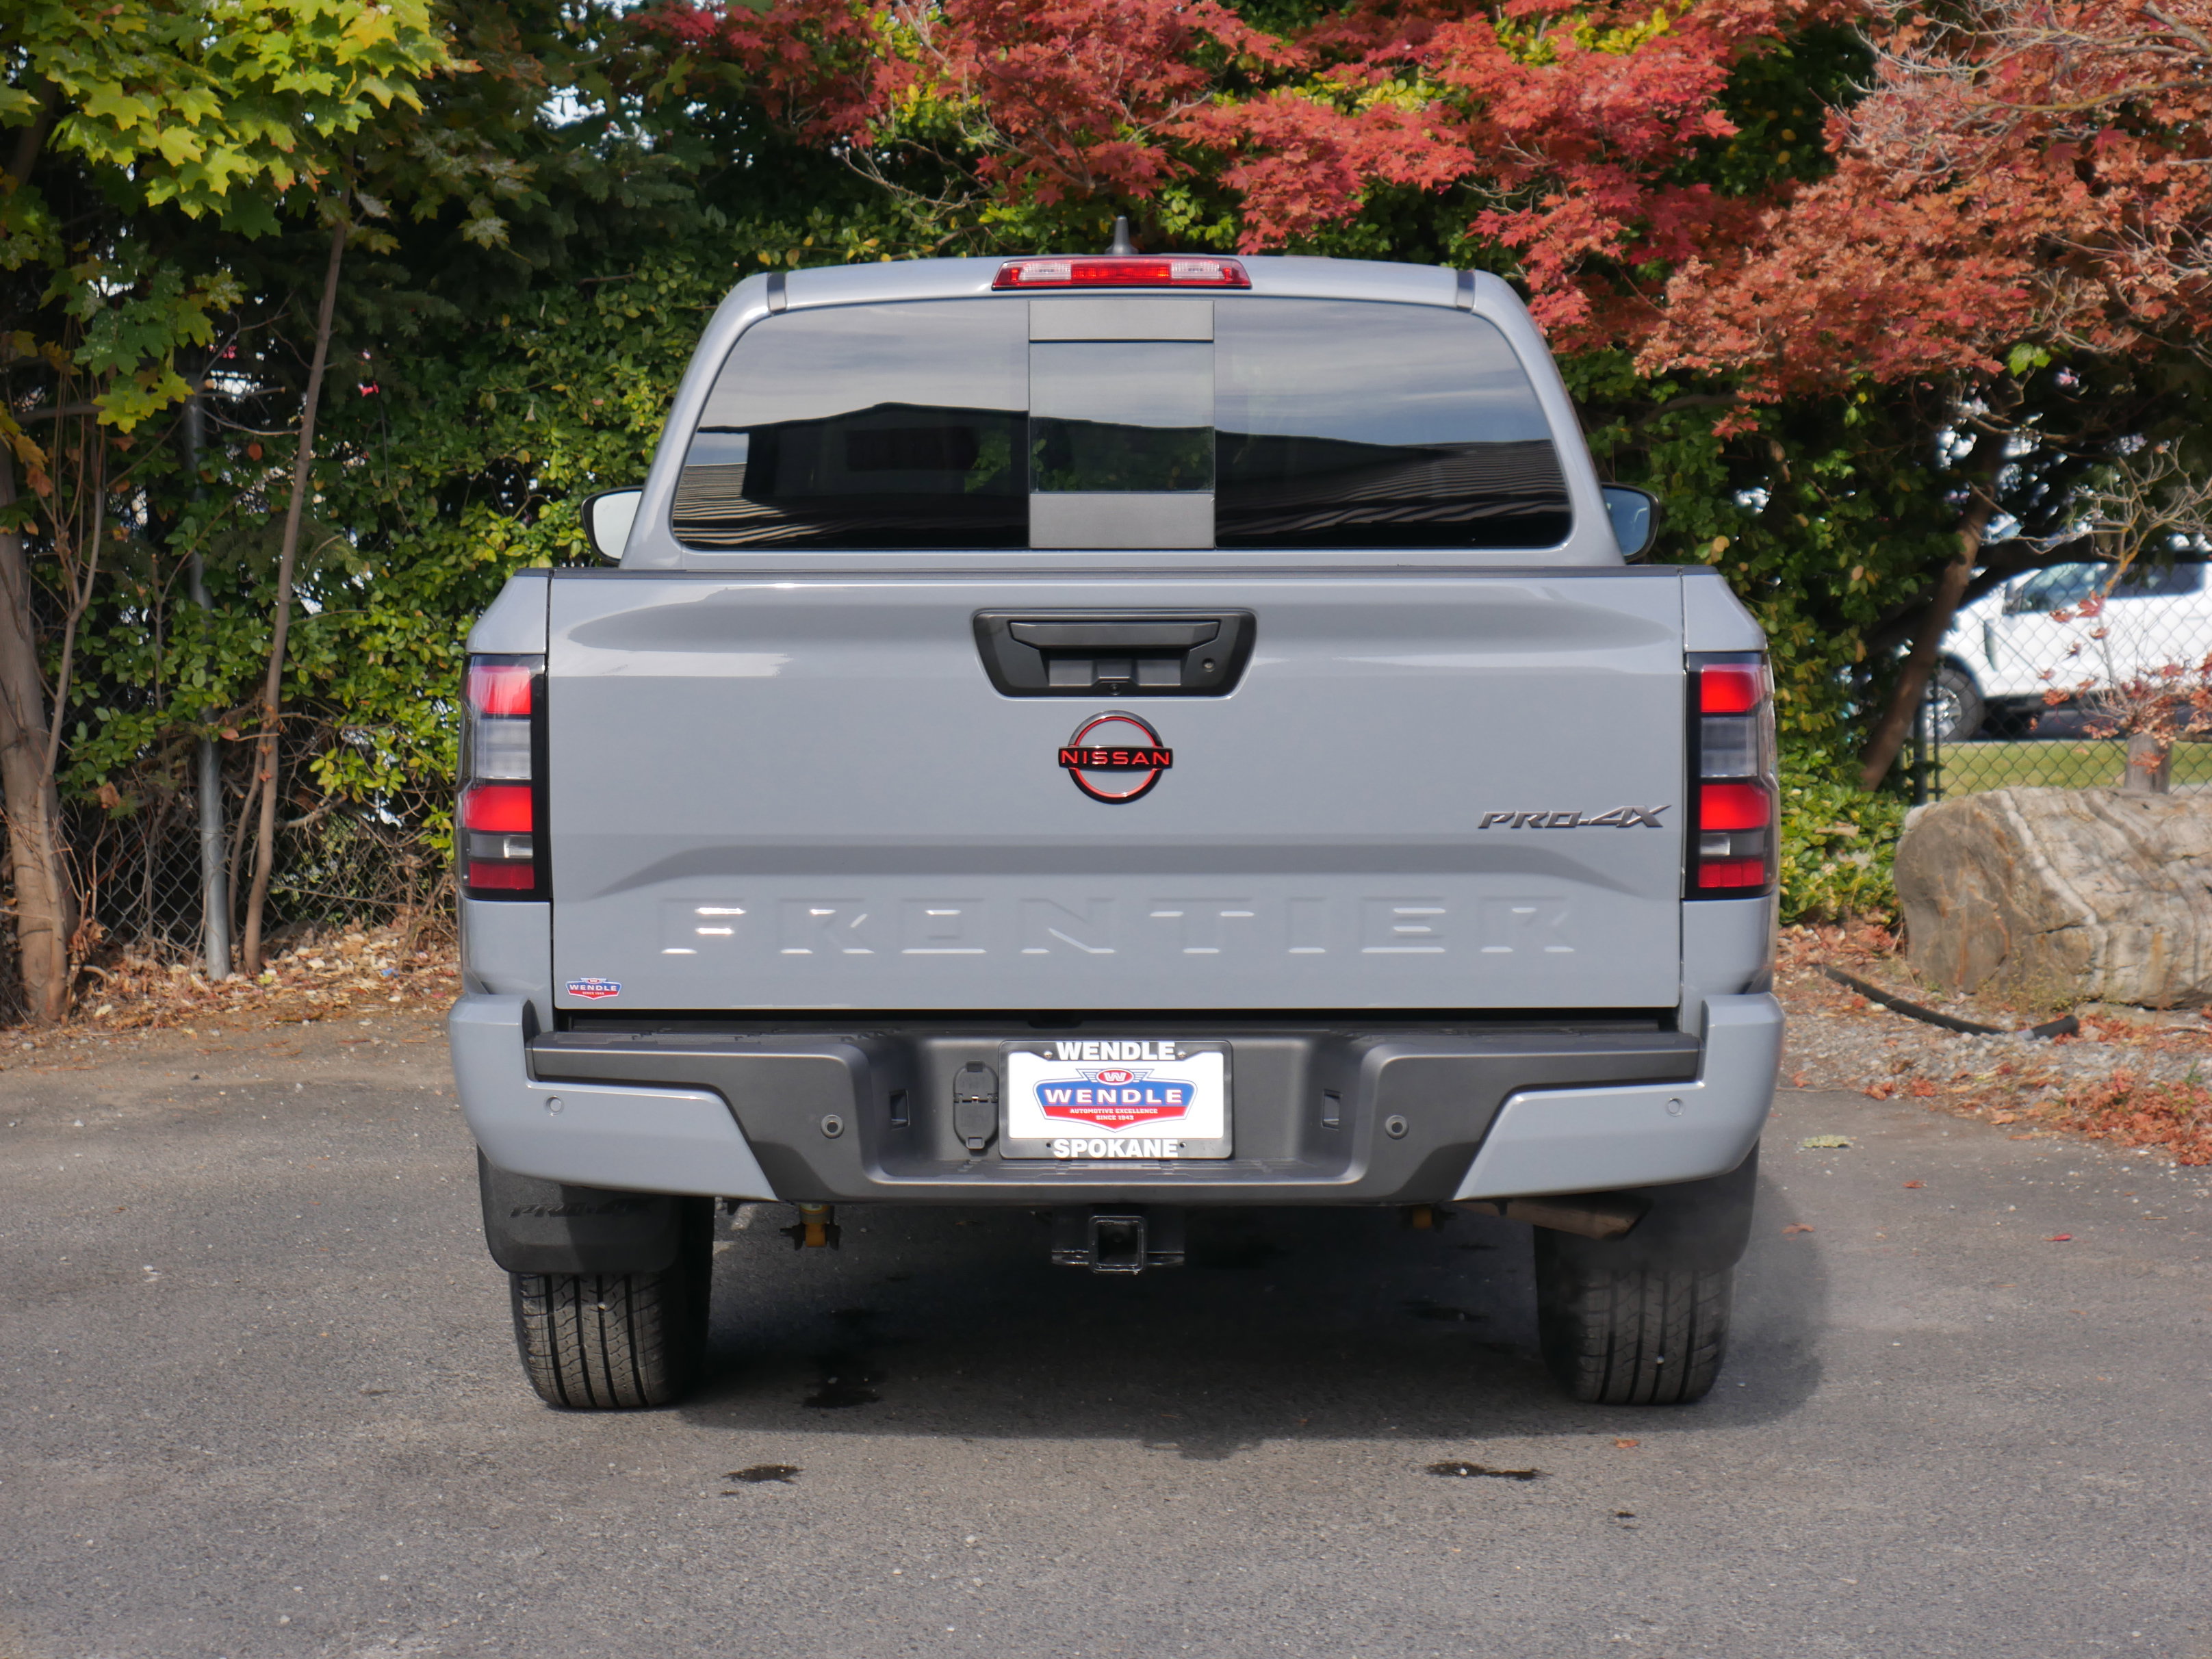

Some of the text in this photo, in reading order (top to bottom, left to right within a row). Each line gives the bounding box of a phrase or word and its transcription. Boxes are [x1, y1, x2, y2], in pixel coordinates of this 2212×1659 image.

[1061, 750, 1170, 765] NISSAN
[1477, 804, 1672, 829] PRO-4X
[658, 897, 1576, 955] FRONTIER
[1056, 1041, 1176, 1061] WENDLE
[1044, 1088, 1183, 1105] WENDLE
[1053, 1138, 1179, 1159] SPOKANE
